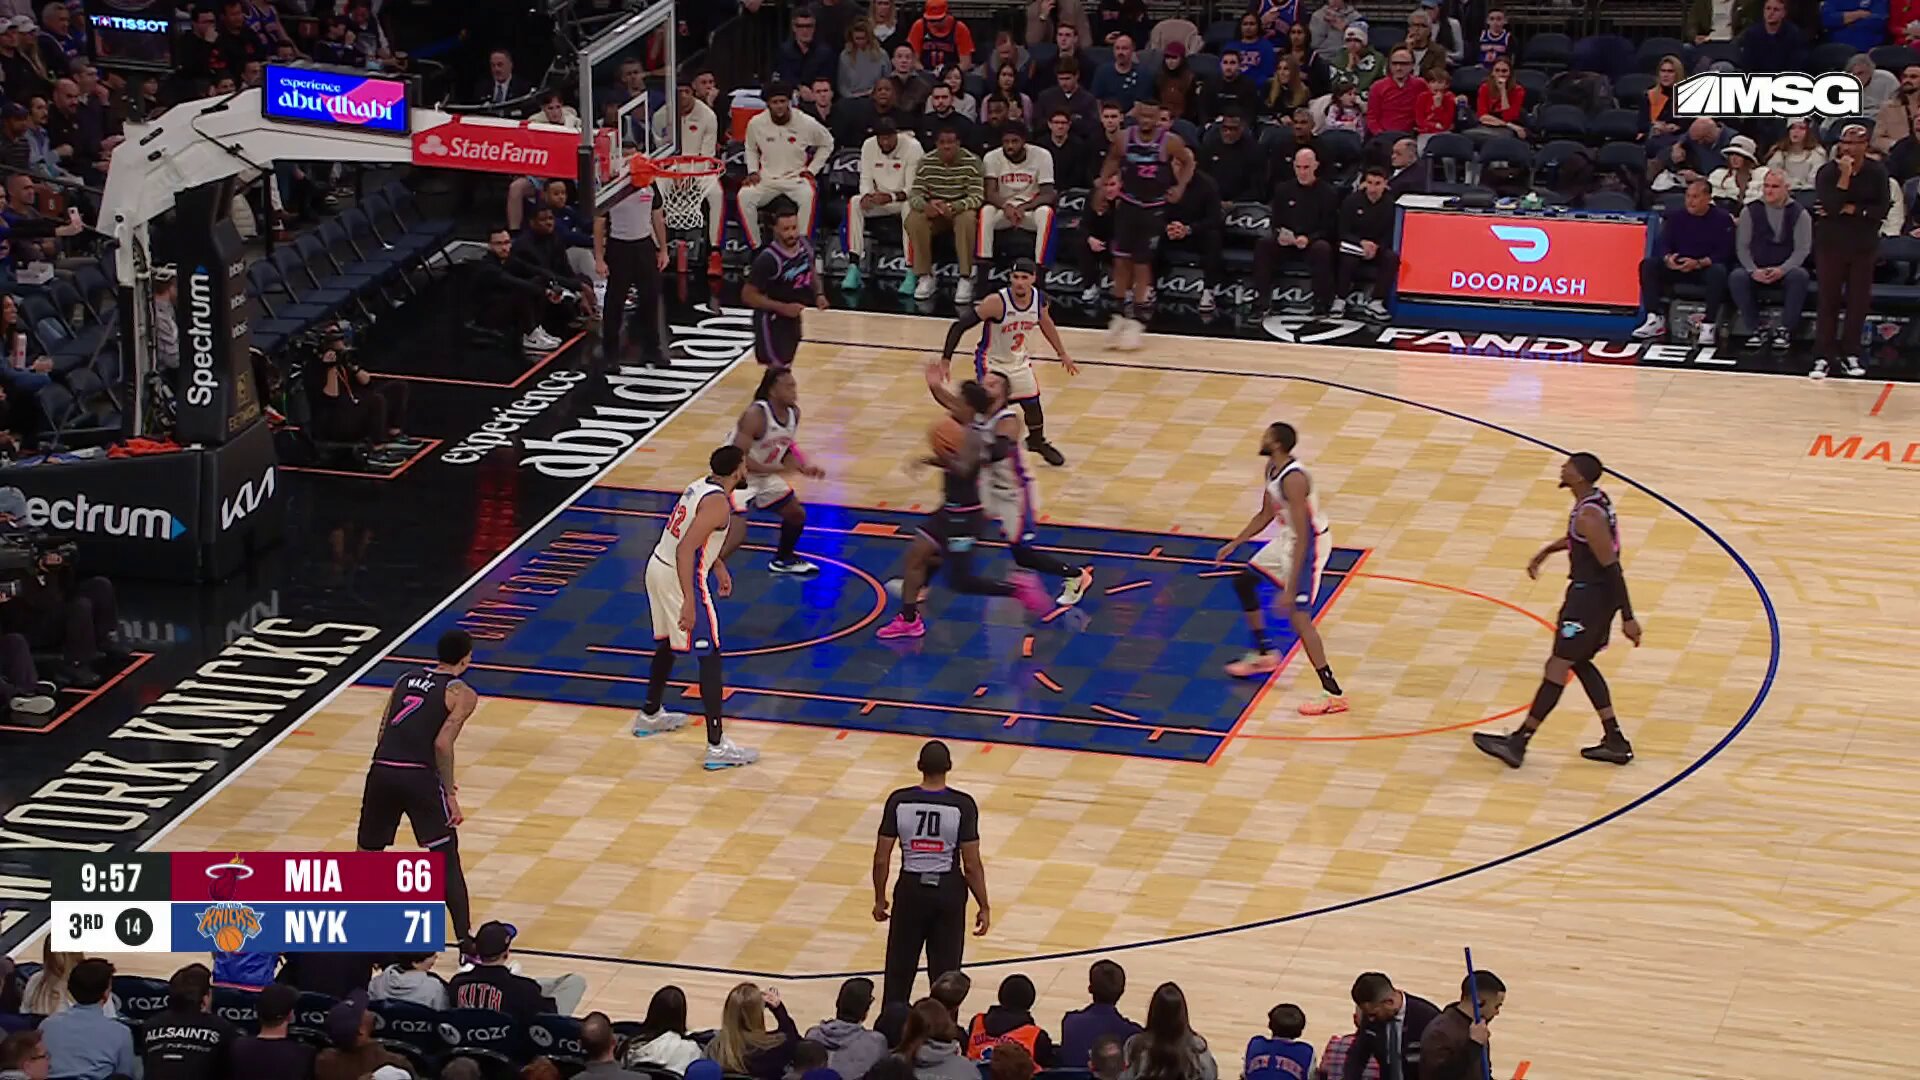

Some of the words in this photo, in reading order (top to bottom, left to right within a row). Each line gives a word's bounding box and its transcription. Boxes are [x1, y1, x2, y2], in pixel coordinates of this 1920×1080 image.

[112, 17, 168, 33] TISSOT
[280, 77, 341, 92] experience
[278, 90, 322, 112] abu
[325, 94, 393, 120] dhabi
[1451, 271, 1586, 295] DOORDASH
[186, 273, 219, 406] Spectrum
[1010, 333, 1024, 352] 3
[1376, 327, 1736, 366] FANDUEL
[441, 369, 588, 464] experience
[519, 404, 674, 478] abu
[26, 493, 171, 540] ectrum
[498, 531, 621, 595] EDITION
[108, 618, 381, 749] KNICKS
[391, 695, 425, 727] 7
[915, 810, 940, 836] 70
[458, 983, 501, 1013] KITH
[146, 1026, 220, 1044] ALLSAINTS
[466, 1024, 511, 1041] razr
